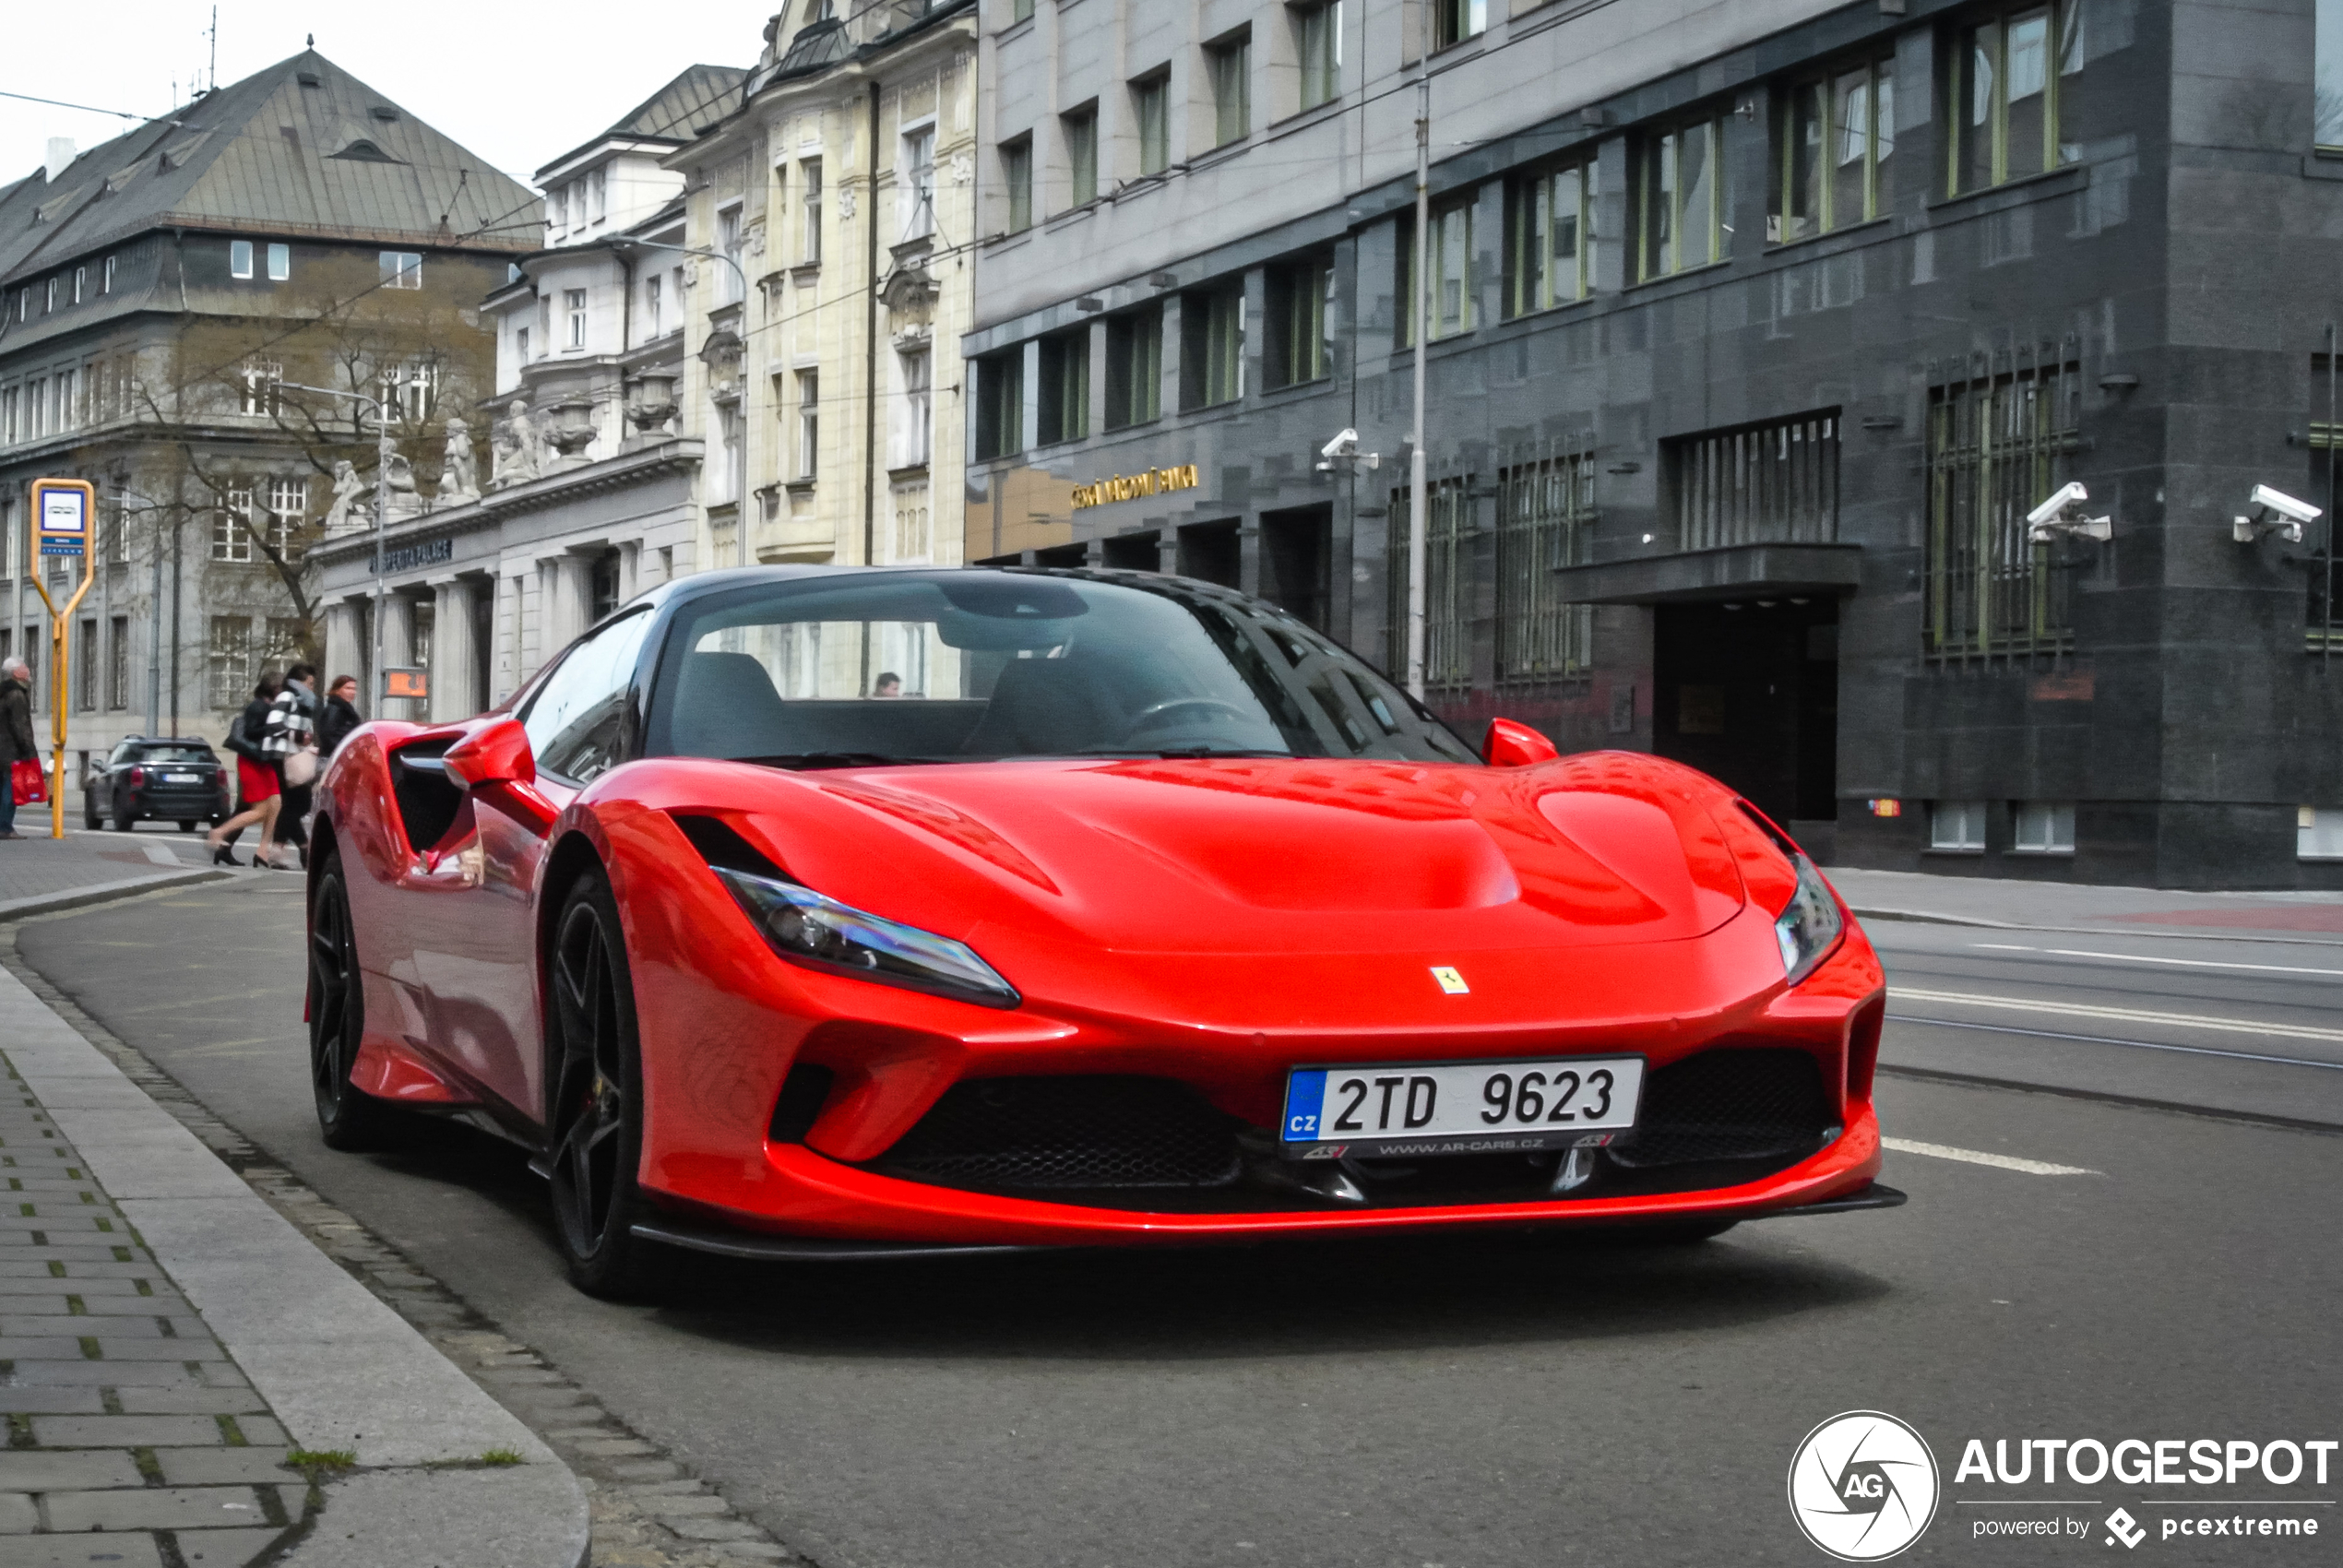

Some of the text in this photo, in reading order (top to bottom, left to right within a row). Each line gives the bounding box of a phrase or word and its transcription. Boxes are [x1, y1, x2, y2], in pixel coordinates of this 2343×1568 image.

[1333, 1068, 1614, 1132] 2TD 9623
[1290, 1115, 1315, 1133] CZ
[1379, 1139, 1544, 1155] WWW.AR-CARS.CZ
